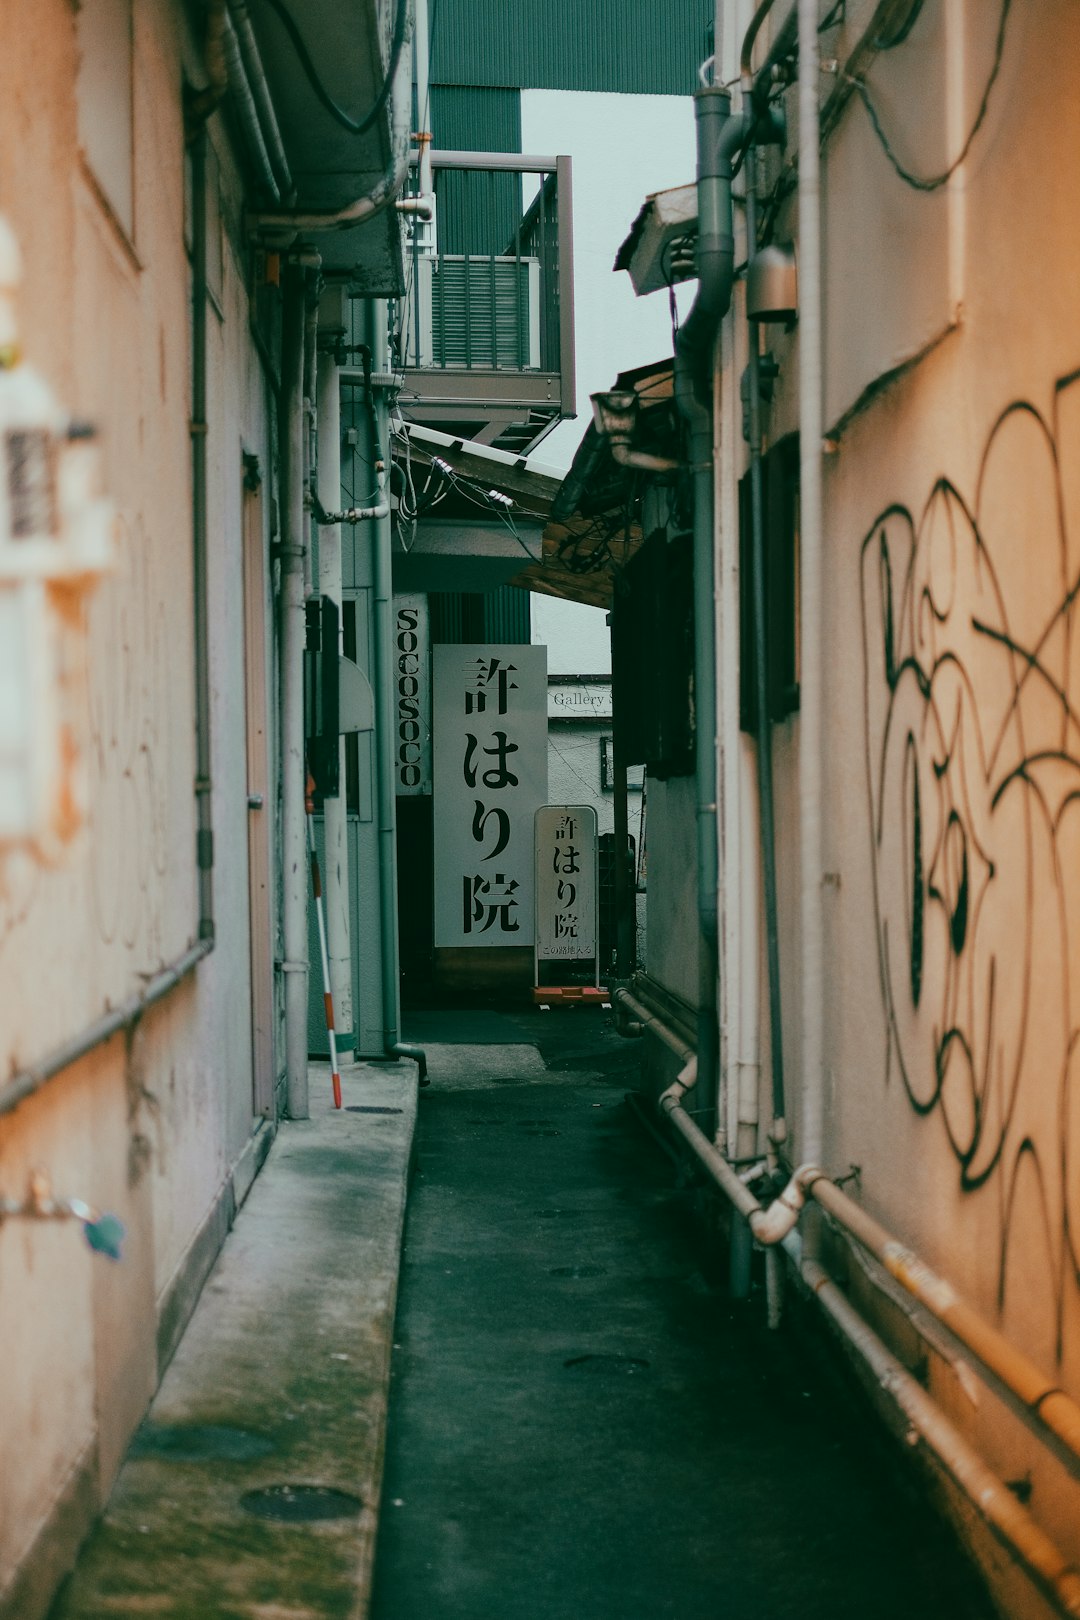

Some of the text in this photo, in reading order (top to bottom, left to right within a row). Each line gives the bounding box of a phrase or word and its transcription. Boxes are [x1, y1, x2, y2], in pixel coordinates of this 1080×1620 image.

[397, 609, 421, 786] SOCOSOCO
[554, 692, 604, 707] Gallery
[463, 657, 520, 935] 許はり院
[552, 816, 580, 938] 許はり院
